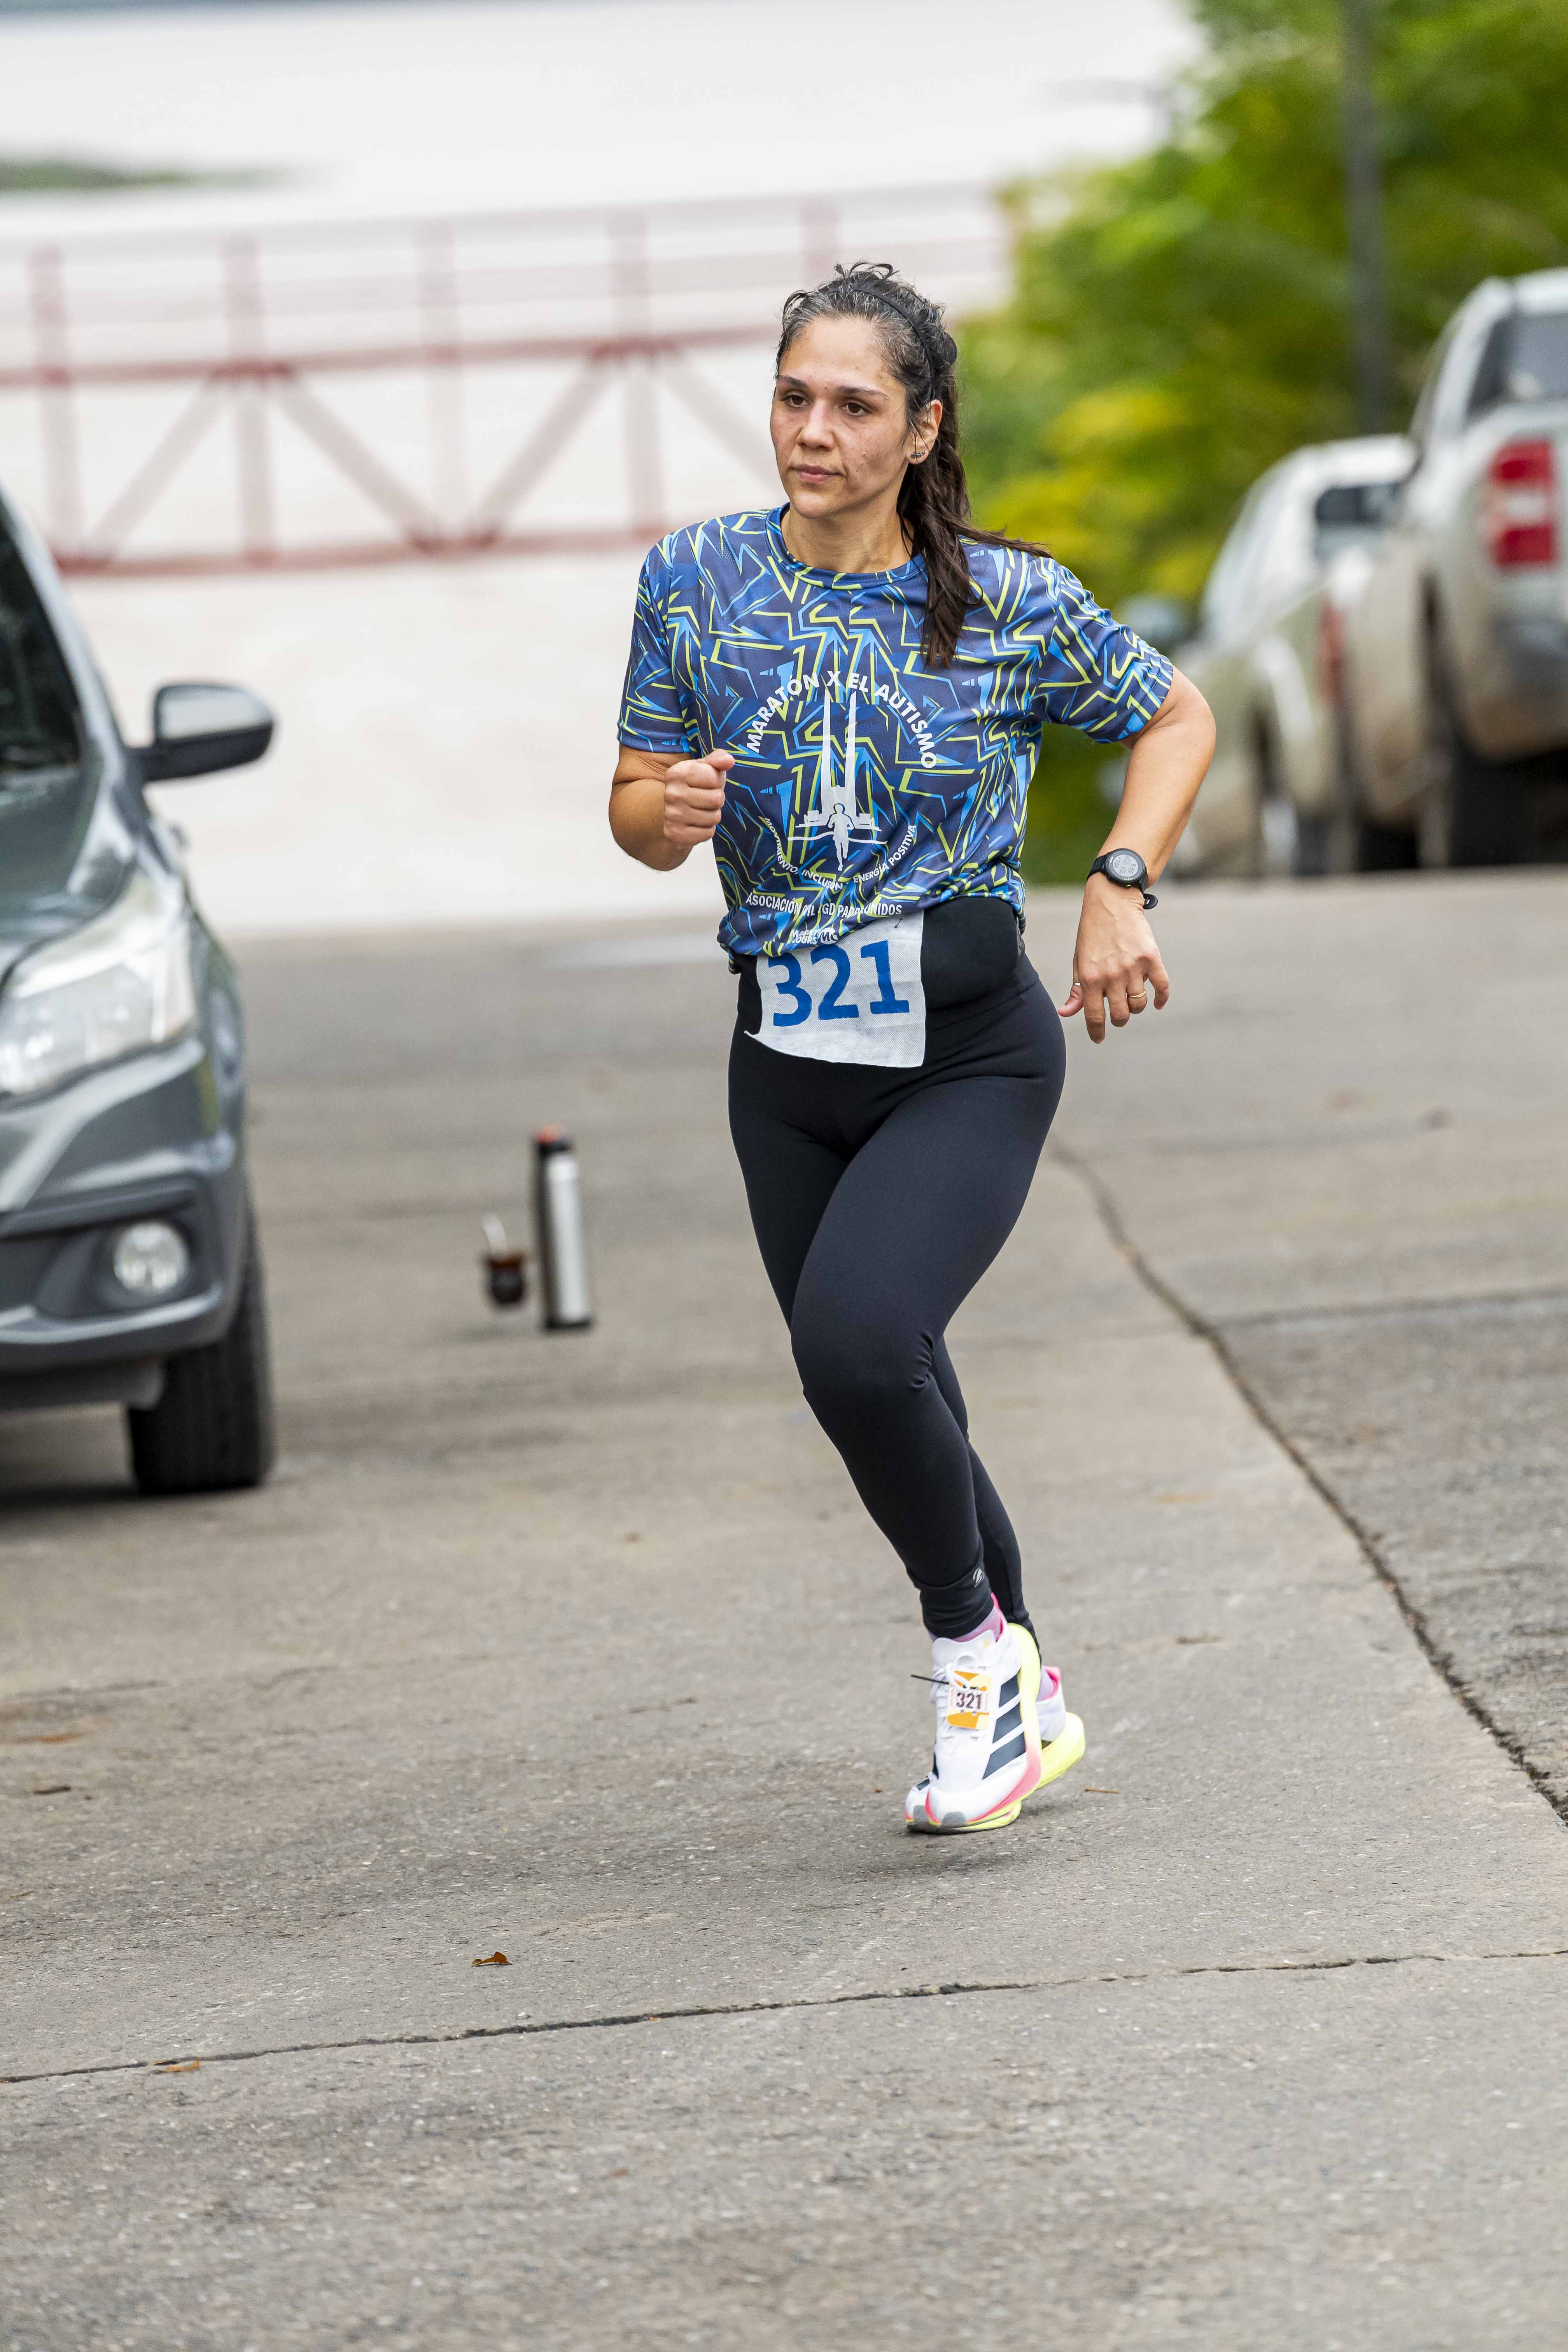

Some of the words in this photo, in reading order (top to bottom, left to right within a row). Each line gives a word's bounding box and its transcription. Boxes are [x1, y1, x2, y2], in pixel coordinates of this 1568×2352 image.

[746, 672, 820, 754] MARATÓN
[827, 670, 841, 687] X
[848, 672, 869, 693] EL
[873, 684, 937, 768] AUTISMO
[853, 863, 890, 883] ENERGÍA
[888, 825, 917, 866] POSITIVA
[746, 892, 802, 915] ASOCIACIÓN
[837, 905, 864, 919] PADR
[864, 902, 902, 916] UNIDOS
[768, 940, 909, 1026] 321
[956, 1692, 982, 1710] 321
